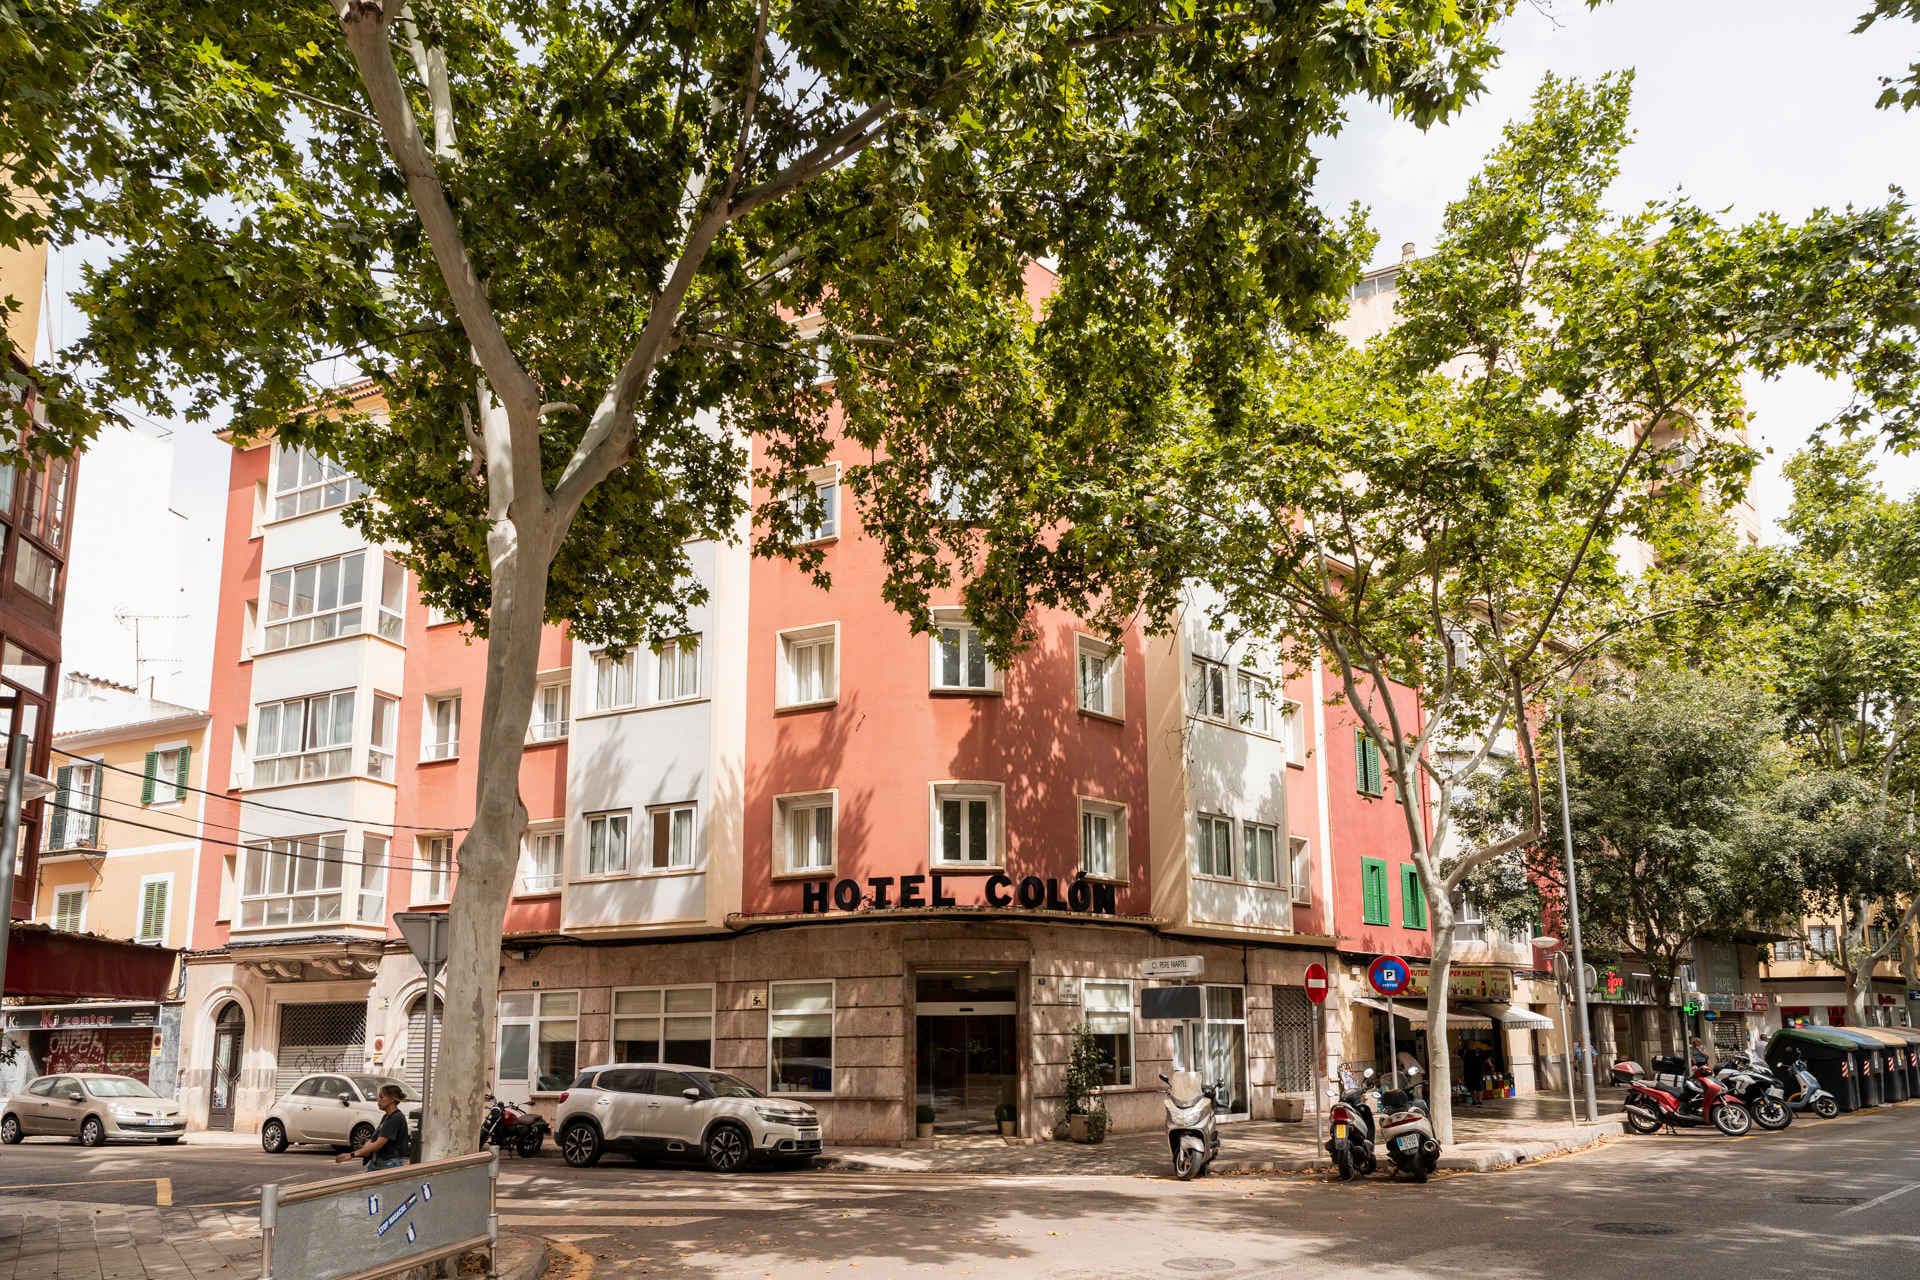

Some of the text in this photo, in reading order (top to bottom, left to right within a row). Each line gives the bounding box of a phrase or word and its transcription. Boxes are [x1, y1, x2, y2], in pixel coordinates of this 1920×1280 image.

[802, 871, 1117, 914] HOTEL COLÓN
[1386, 971, 1393, 980] P
